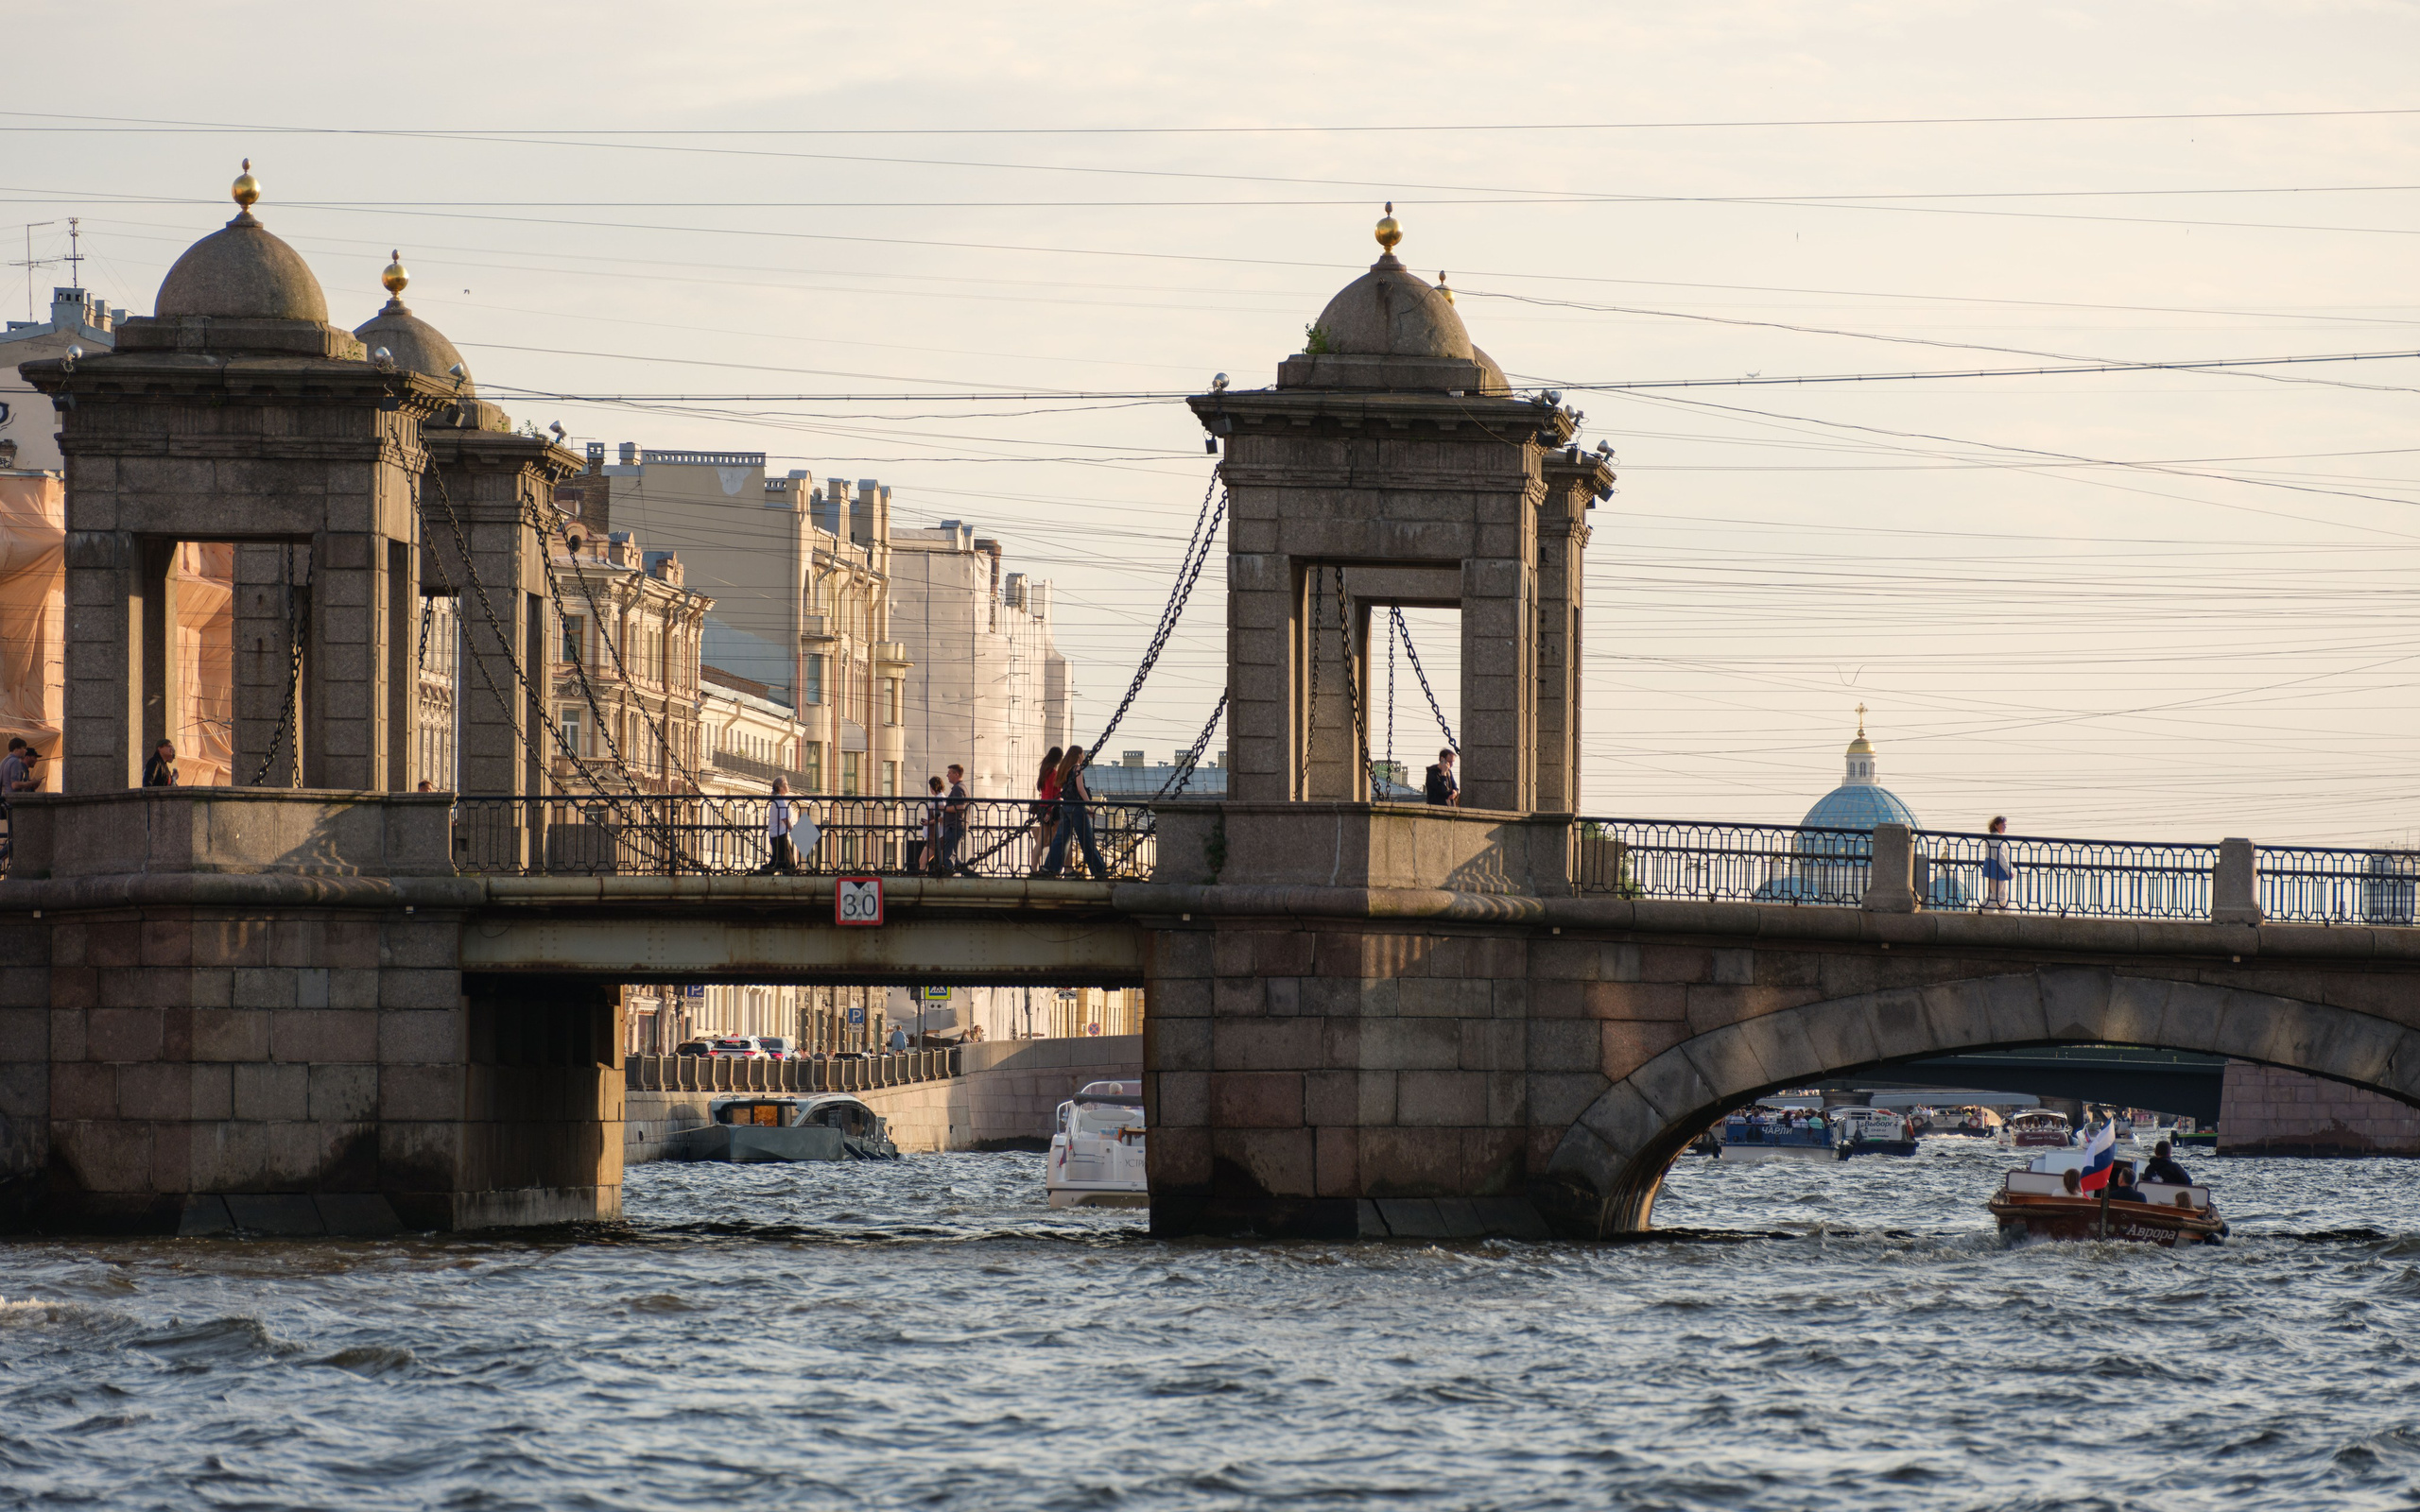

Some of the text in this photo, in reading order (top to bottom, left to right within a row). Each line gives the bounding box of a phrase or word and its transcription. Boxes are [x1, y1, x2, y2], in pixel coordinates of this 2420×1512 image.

[853, 1009, 861, 1022] P
[1761, 1126, 1793, 1135] ЧАРЛИ
[2126, 1224, 2177, 1242] Аврора
